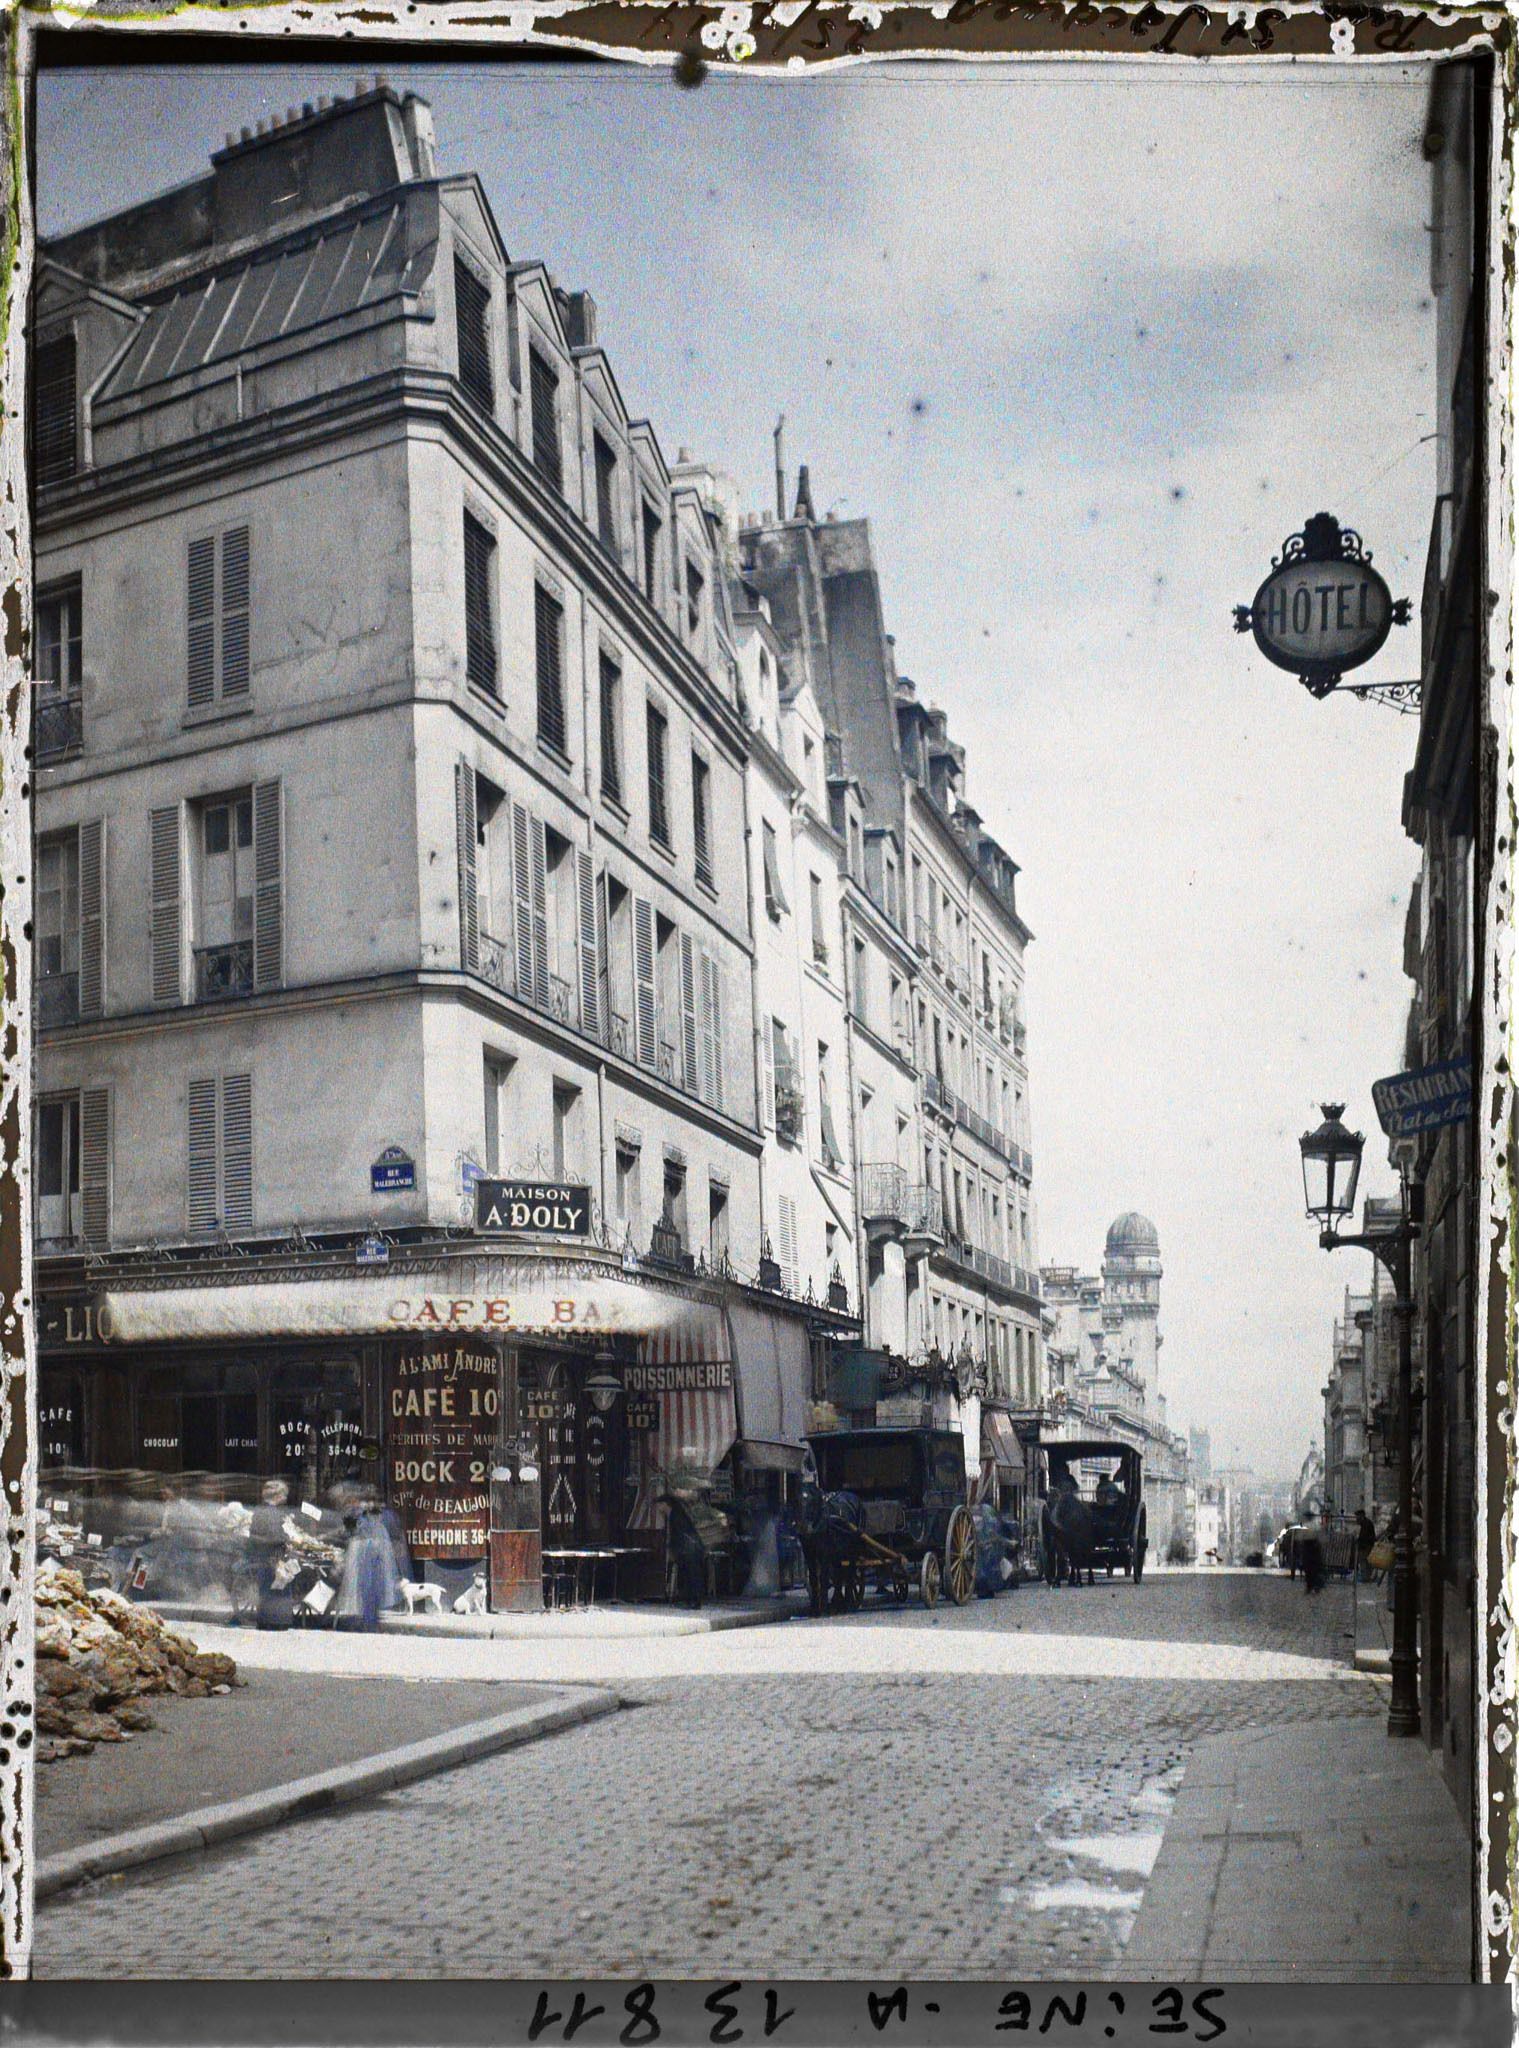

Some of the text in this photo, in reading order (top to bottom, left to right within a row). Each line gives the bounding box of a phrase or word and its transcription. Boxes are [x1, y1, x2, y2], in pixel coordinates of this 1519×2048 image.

[1268, 581, 1377, 636] HÔTEL
[502, 1188, 570, 1201] MAISON
[387, 1298, 511, 1324] CAFE
[624, 1363, 731, 1392] POISSONNERIE
[279, 1421, 312, 1436] BOCK
[143, 1438, 179, 1448] CHOCOLAT
[225, 1438, 240, 1447] LAIT
[447, 1433, 465, 1446] DE
[395, 1461, 455, 1482] BOCK
